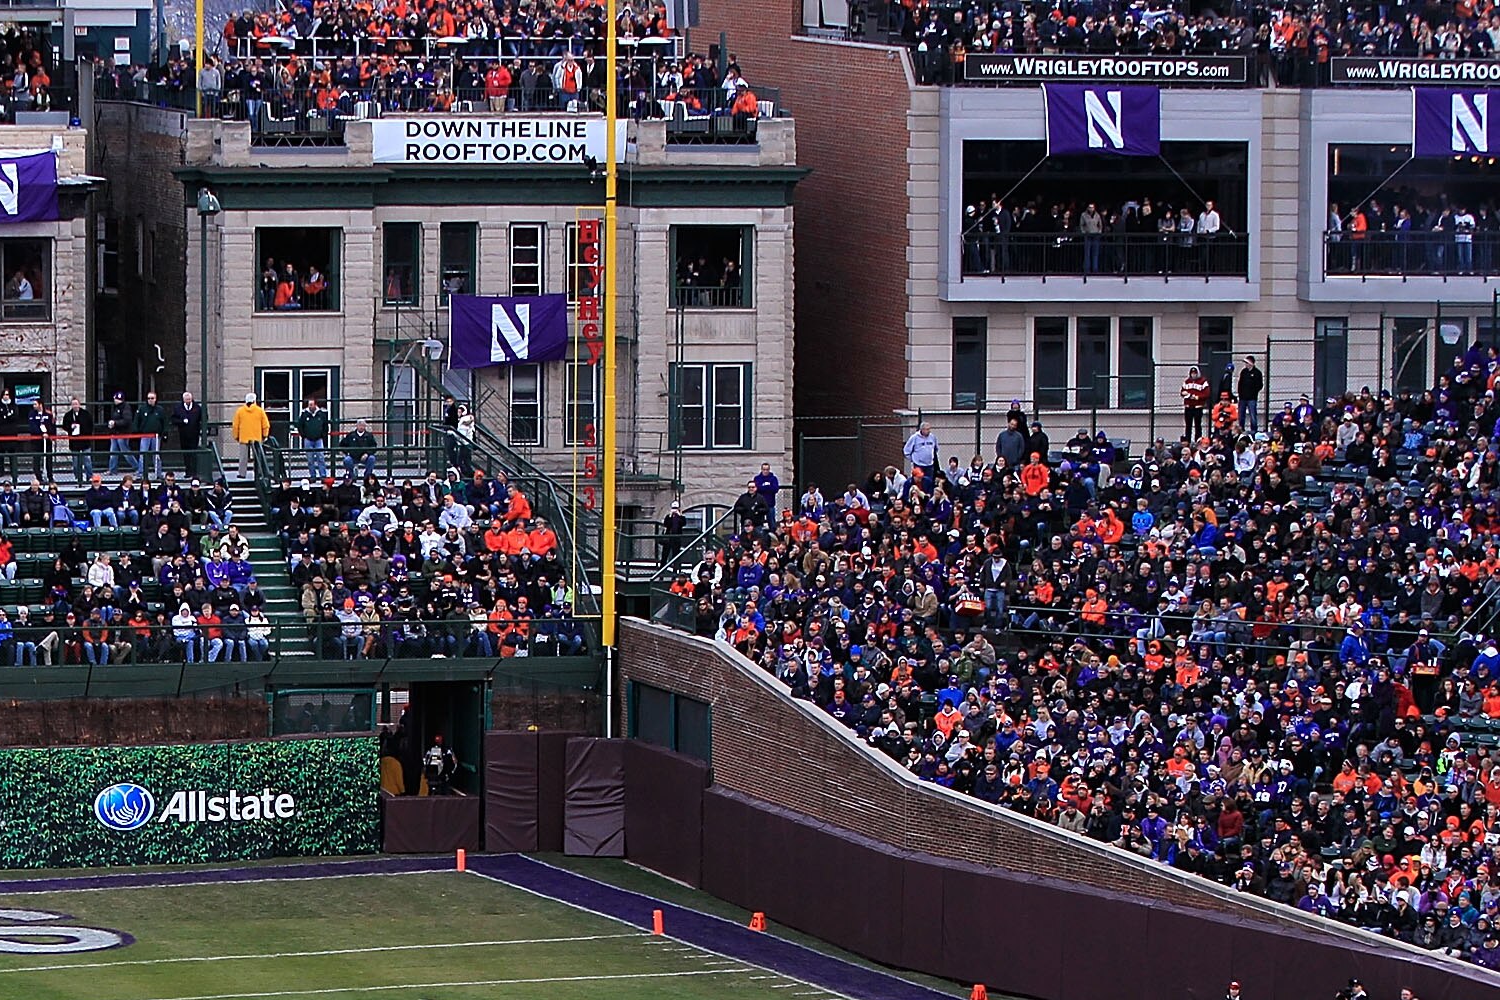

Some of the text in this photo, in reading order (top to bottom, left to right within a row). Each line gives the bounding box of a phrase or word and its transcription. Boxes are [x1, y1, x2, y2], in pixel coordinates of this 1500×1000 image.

[405, 121, 587, 137] DOWN THE LINE
[1084, 89, 1125, 149] N
[1451, 93, 1488, 153] N
[405, 144, 587, 161] ROOFTOP.COM
[491, 303, 530, 363] N
[158, 787, 295, 823] Allstate
